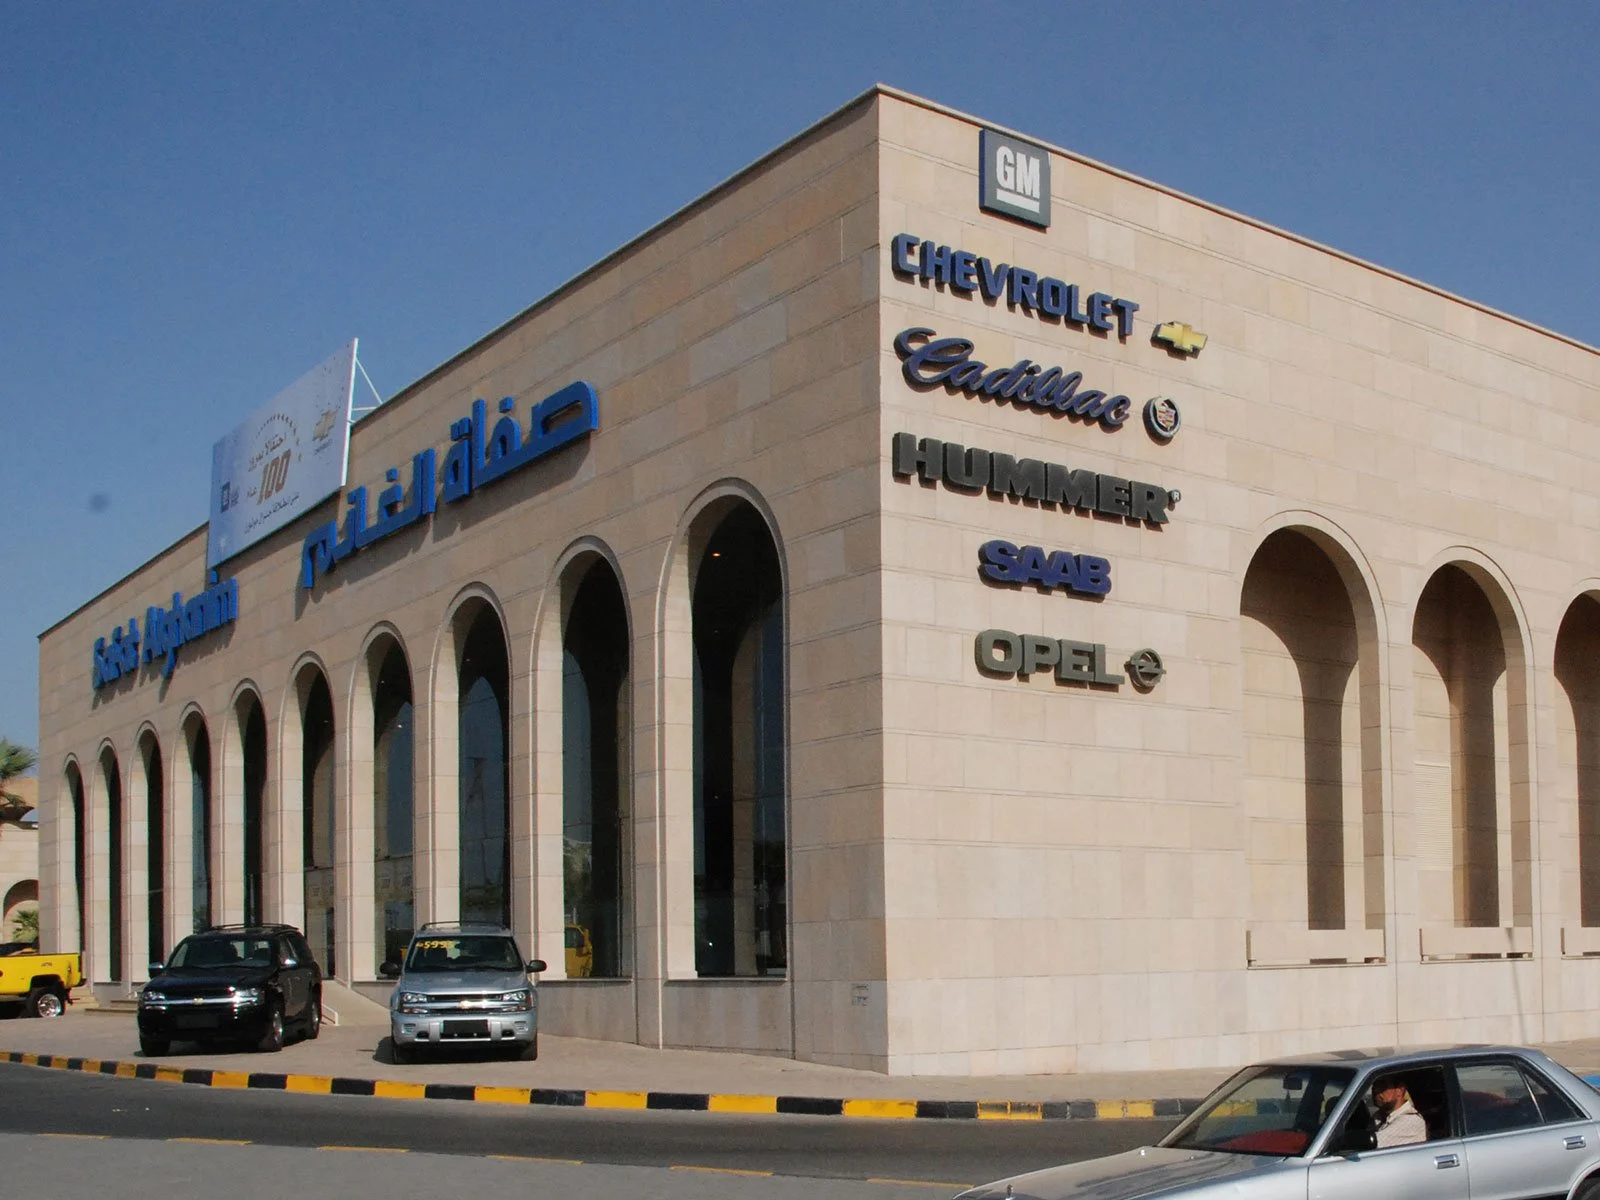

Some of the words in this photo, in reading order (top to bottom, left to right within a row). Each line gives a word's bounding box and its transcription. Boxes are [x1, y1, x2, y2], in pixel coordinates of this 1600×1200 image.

[997, 146, 1040, 199] GM
[891, 233, 1140, 338] CHEVROLET
[894, 327, 1132, 426] Cadillac
[256, 448, 292, 505] 100
[300, 448, 436, 589] الغانم
[978, 540, 1112, 595] SAAB
[143, 570, 238, 680] Alghanim
[975, 628, 1125, 686] OPEL
